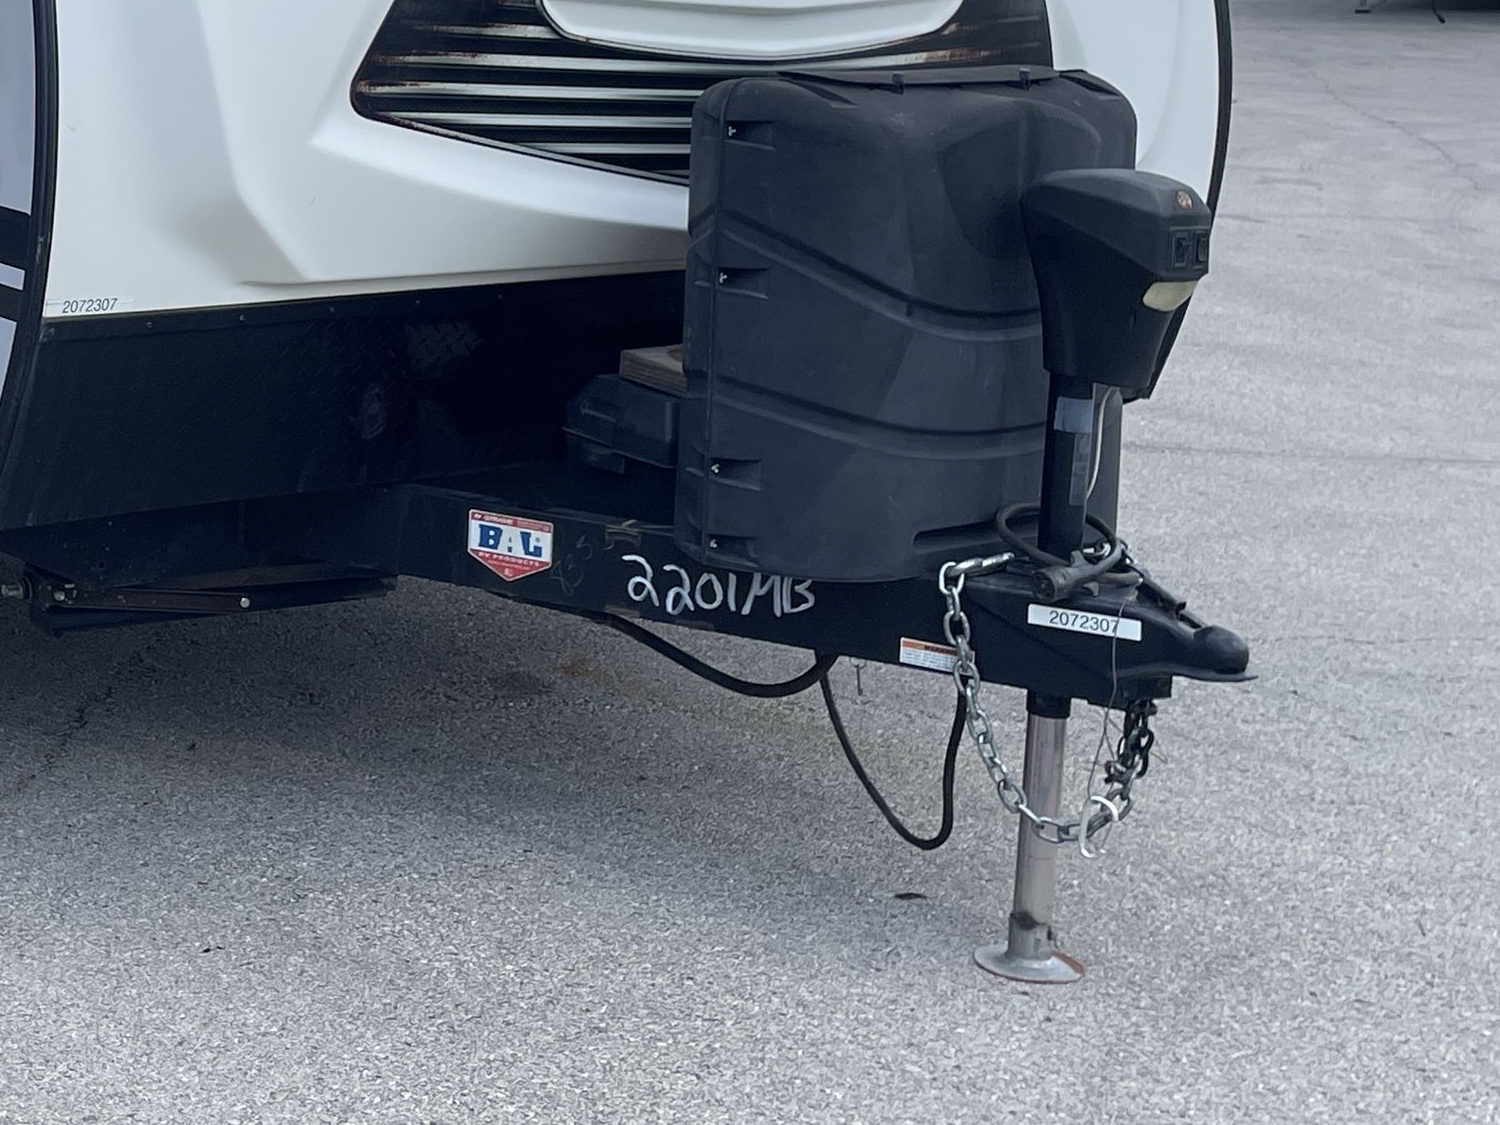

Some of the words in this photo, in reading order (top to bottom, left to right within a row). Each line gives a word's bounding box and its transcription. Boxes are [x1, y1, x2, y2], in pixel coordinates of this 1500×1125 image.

[61, 297, 118, 314] 2072307
[621, 554, 816, 618] 2201MB
[1049, 610, 1119, 634] 2072307
